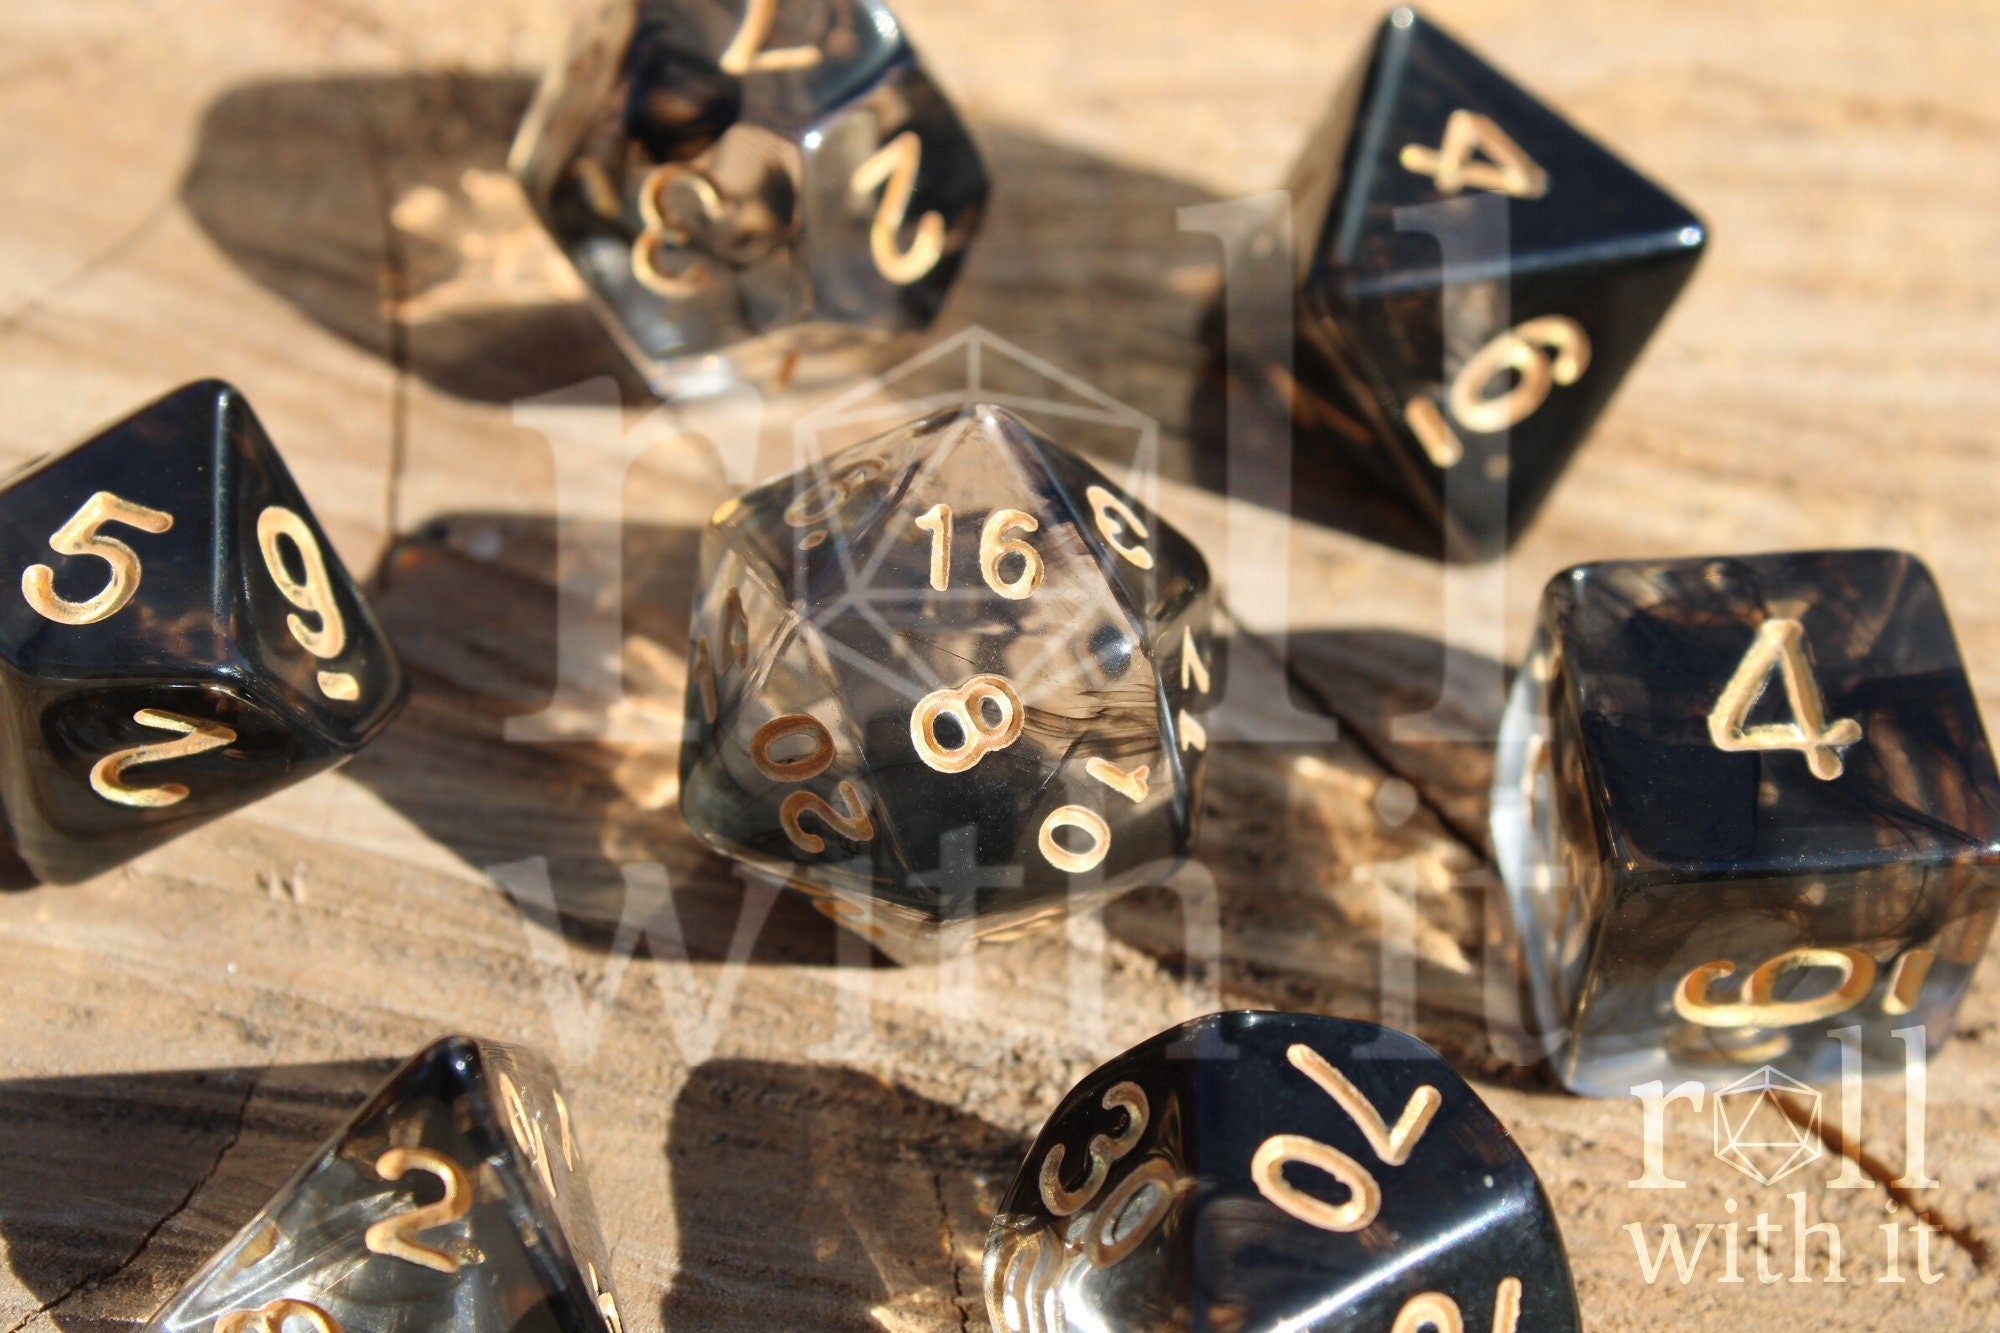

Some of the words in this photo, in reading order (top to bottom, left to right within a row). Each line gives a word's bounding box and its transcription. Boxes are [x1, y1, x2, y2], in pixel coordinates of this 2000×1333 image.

[850, 131, 947, 286] 2
[1400, 109, 1549, 200] 4
[632, 164, 726, 298] 3
[21, 491, 174, 625] 5
[914, 502, 1046, 600] 16
[1085, 485, 1155, 570] 3
[89, 708, 238, 808] 2
[910, 673, 1026, 774] 8
[1707, 618, 1862, 781] 4
[1250, 1043, 1443, 1233] 70
[365, 1147, 475, 1274] 2
